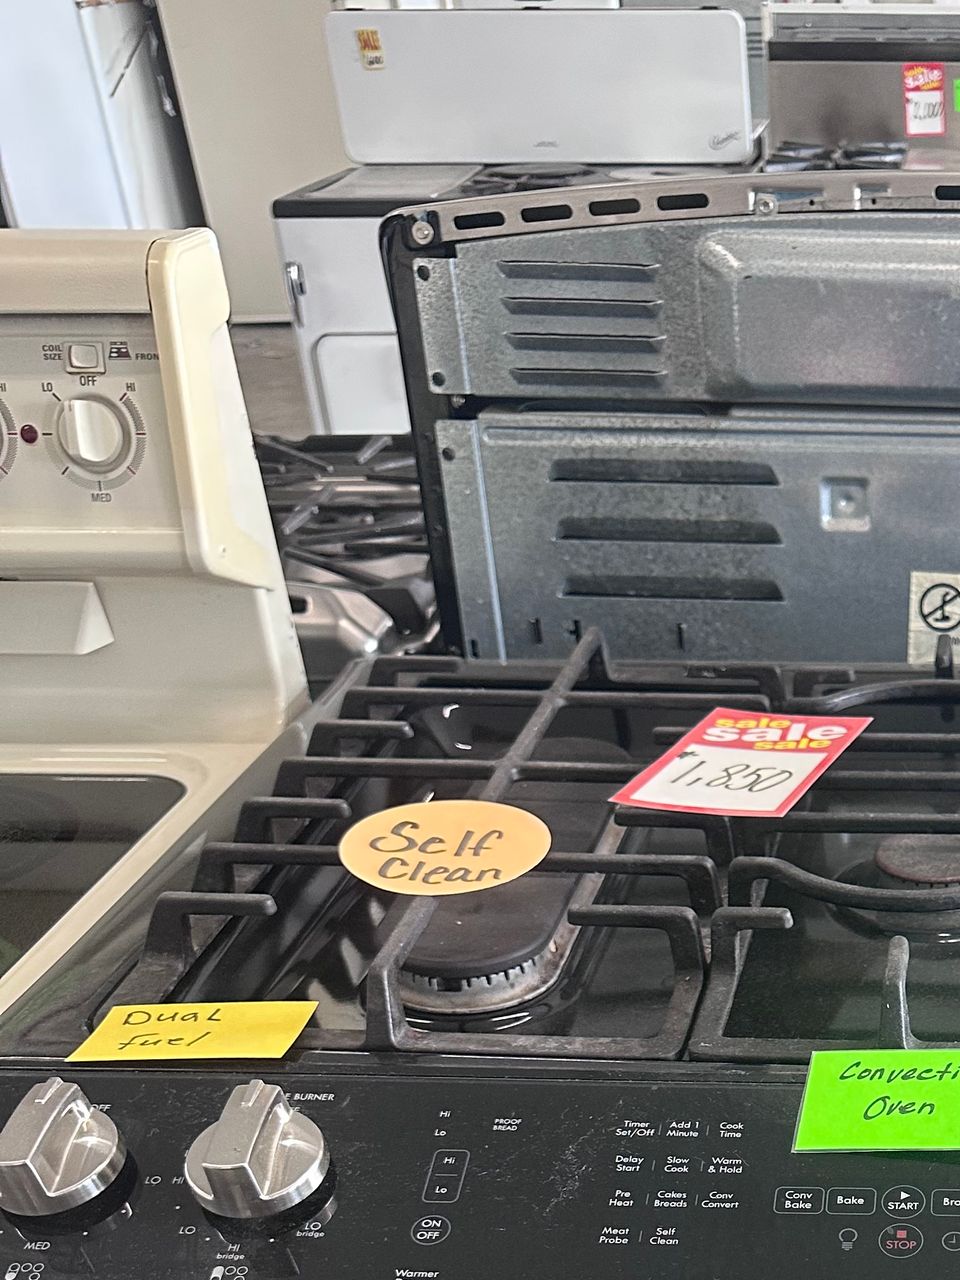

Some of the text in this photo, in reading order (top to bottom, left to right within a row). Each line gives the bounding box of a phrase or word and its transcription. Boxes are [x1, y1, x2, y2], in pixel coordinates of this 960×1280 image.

[904, 70, 942, 88] sale
[43, 353, 63, 361] SIZE
[79, 376, 97, 386] OFF
[42, 382, 53, 392] LO
[126, 383, 136, 392] HI
[91, 493, 111, 502] MED
[714, 717, 791, 729] sale
[702, 723, 848, 742] sale
[753, 738, 833, 750] sale
[369, 820, 504, 857] Self
[377, 857, 502, 885] Clean
[293, 1092, 335, 1101] BURNER
[863, 1095, 936, 1120] Oven
[439, 1110, 451, 1118] Hi
[624, 1120, 651, 1128] Timer
[669, 1121, 692, 1129] Add
[719, 1122, 744, 1130] Cook
[434, 1129, 447, 1137] Lo
[615, 1128, 656, 1138] Set/Off
[719, 1130, 742, 1138] Time
[443, 1156, 456, 1164] Hi
[615, 1155, 644, 1165] Delay
[667, 1156, 690, 1164] Slow
[711, 1157, 742, 1165] Warm
[616, 1164, 640, 1172] Start
[664, 1164, 689, 1173] Cook
[719, 1166, 743, 1174] Hold
[144, 1175, 162, 1185] LO
[172, 1176, 185, 1184] HI
[435, 1186, 448, 1194] Lo
[615, 1189, 631, 1198] Pre
[657, 1190, 687, 1199] Cakes
[709, 1191, 734, 1199] Conv
[785, 1190, 813, 1200] Conv
[609, 1199, 634, 1207] Heat
[654, 1199, 688, 1208] Breads
[701, 1200, 739, 1209] Convert
[784, 1200, 813, 1210] Bake
[836, 1195, 865, 1206] Bake
[887, 1201, 919, 1211] START
[304, 1221, 322, 1231] LO
[421, 1219, 442, 1228] ON
[178, 1226, 196, 1235] LO
[296, 1230, 325, 1238] bridge
[601, 1227, 630, 1235] Meat
[656, 1227, 676, 1236] Self
[416, 1232, 440, 1240] OFF
[599, 1236, 629, 1244] Probe
[650, 1236, 679, 1245] Clean
[24, 1241, 51, 1250] MED
[227, 1244, 241, 1252] HI
[885, 1240, 917, 1250] STOP
[395, 1269, 440, 1278] Warmer
